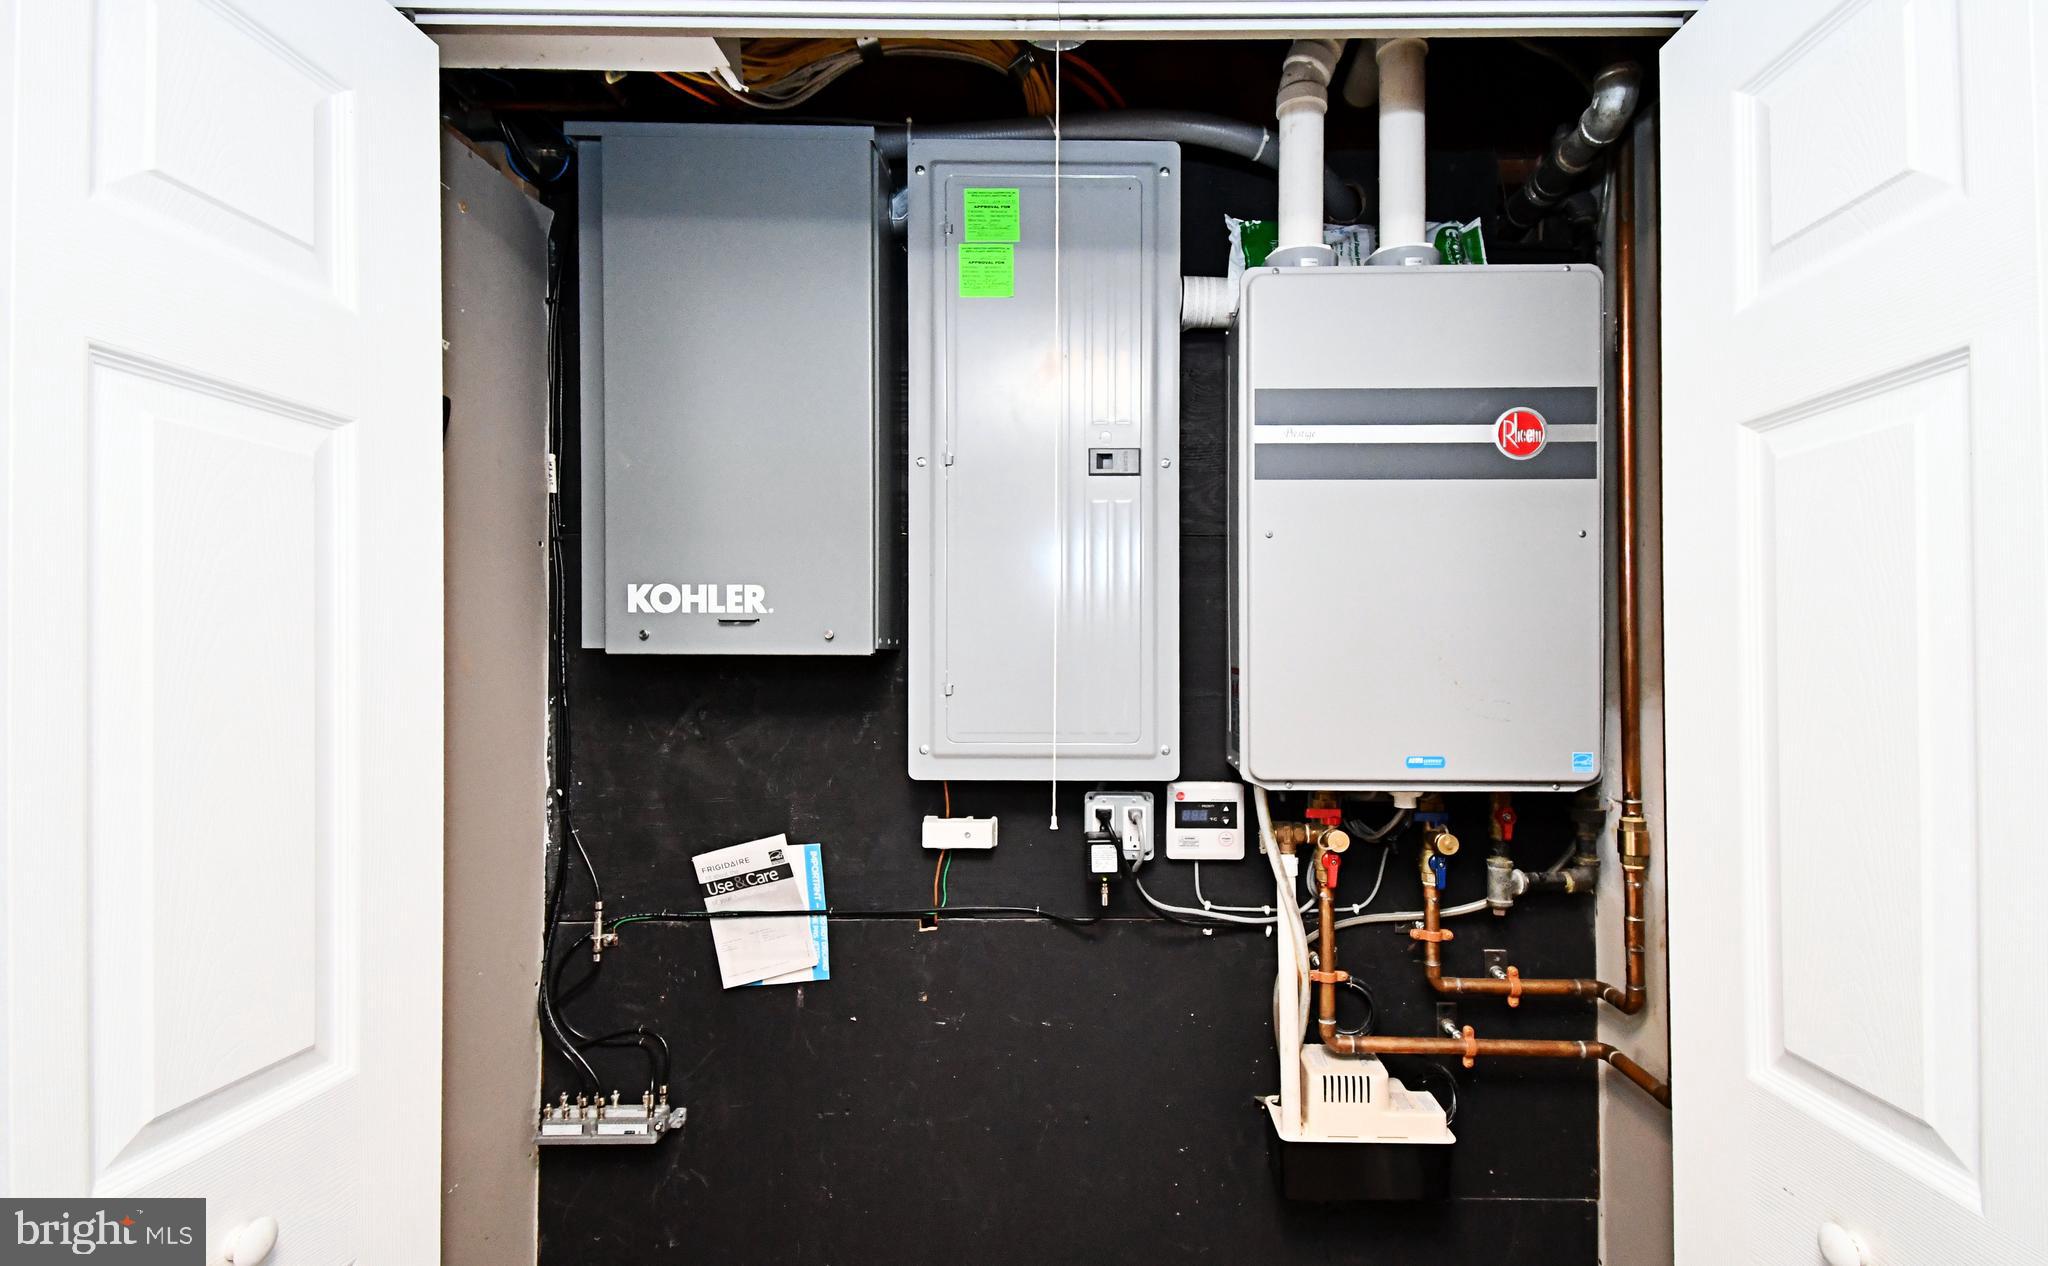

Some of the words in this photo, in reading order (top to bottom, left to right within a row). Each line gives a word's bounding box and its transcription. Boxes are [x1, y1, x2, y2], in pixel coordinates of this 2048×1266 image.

[1502, 413, 1541, 448] Rheem
[702, 857, 751, 873] FRIGIDAIRE
[810, 850, 822, 901] IMPORTANT
[706, 881, 735, 895] Use
[734, 876, 748, 889] &
[745, 869, 780, 886] Care
